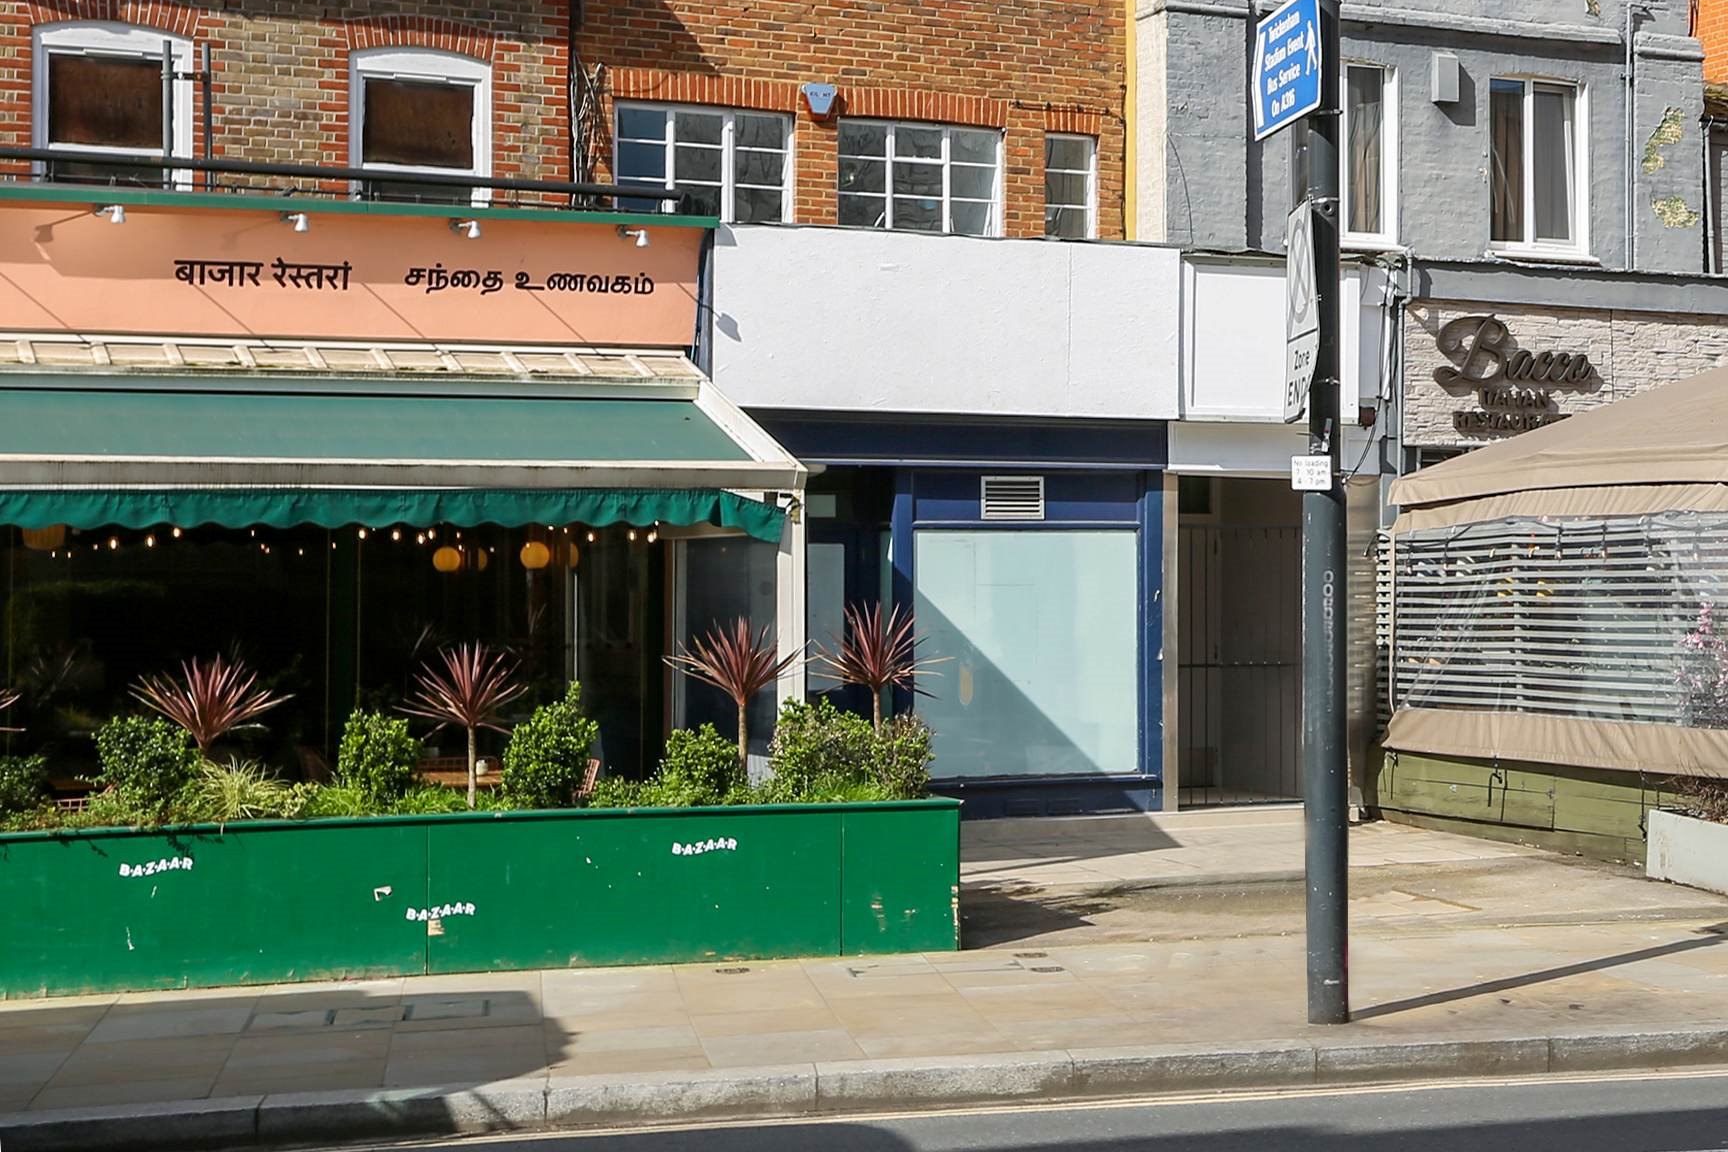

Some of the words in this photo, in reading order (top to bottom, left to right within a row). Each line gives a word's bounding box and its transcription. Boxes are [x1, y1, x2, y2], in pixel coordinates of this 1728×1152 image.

[1266, 77, 1278, 96] Bus
[1278, 62, 1301, 88] Service
[174, 259, 264, 287] बाजार
[404, 263, 504, 295] சந்தை
[515, 271, 655, 295] உணவகம்
[1294, 349, 1310, 370] Zone
[1433, 314, 1594, 384] Bacco
